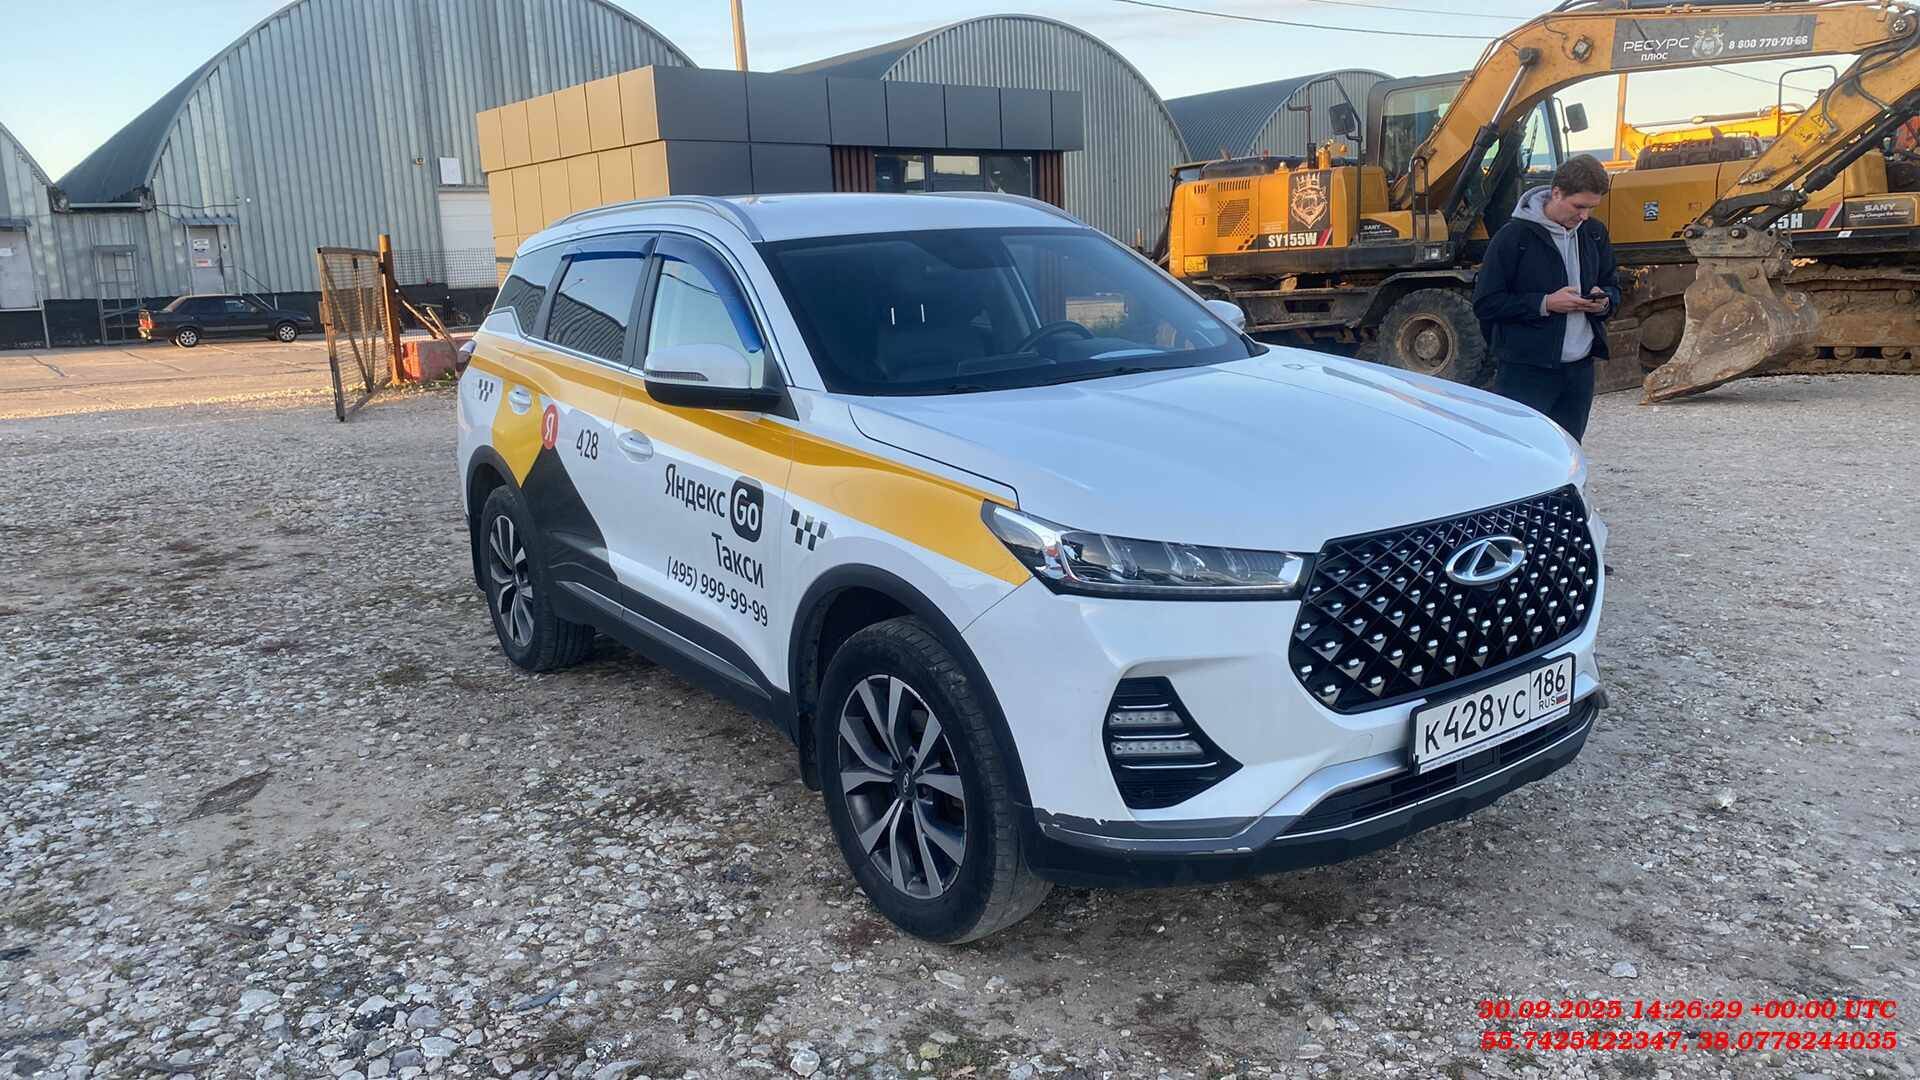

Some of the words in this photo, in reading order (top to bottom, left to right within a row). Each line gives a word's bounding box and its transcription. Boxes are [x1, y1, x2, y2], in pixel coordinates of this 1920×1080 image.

[1623, 37, 1690, 52] РЕСУРС
[1728, 40, 1736, 50] 8
[1864, 203, 1896, 212] SANY
[1268, 231, 1318, 248] SY155W
[544, 412, 555, 442] Я
[576, 429, 599, 460] 428
[664, 463, 726, 519] Яндекс
[732, 487, 760, 533] Go
[711, 531, 764, 589] Такси
[667, 555, 698, 592] (495)
[700, 578, 769, 628] 999-99-99
[1425, 690, 1526, 754] К428УС
[1533, 664, 1566, 700] 186
[1538, 695, 1556, 711] RUS
